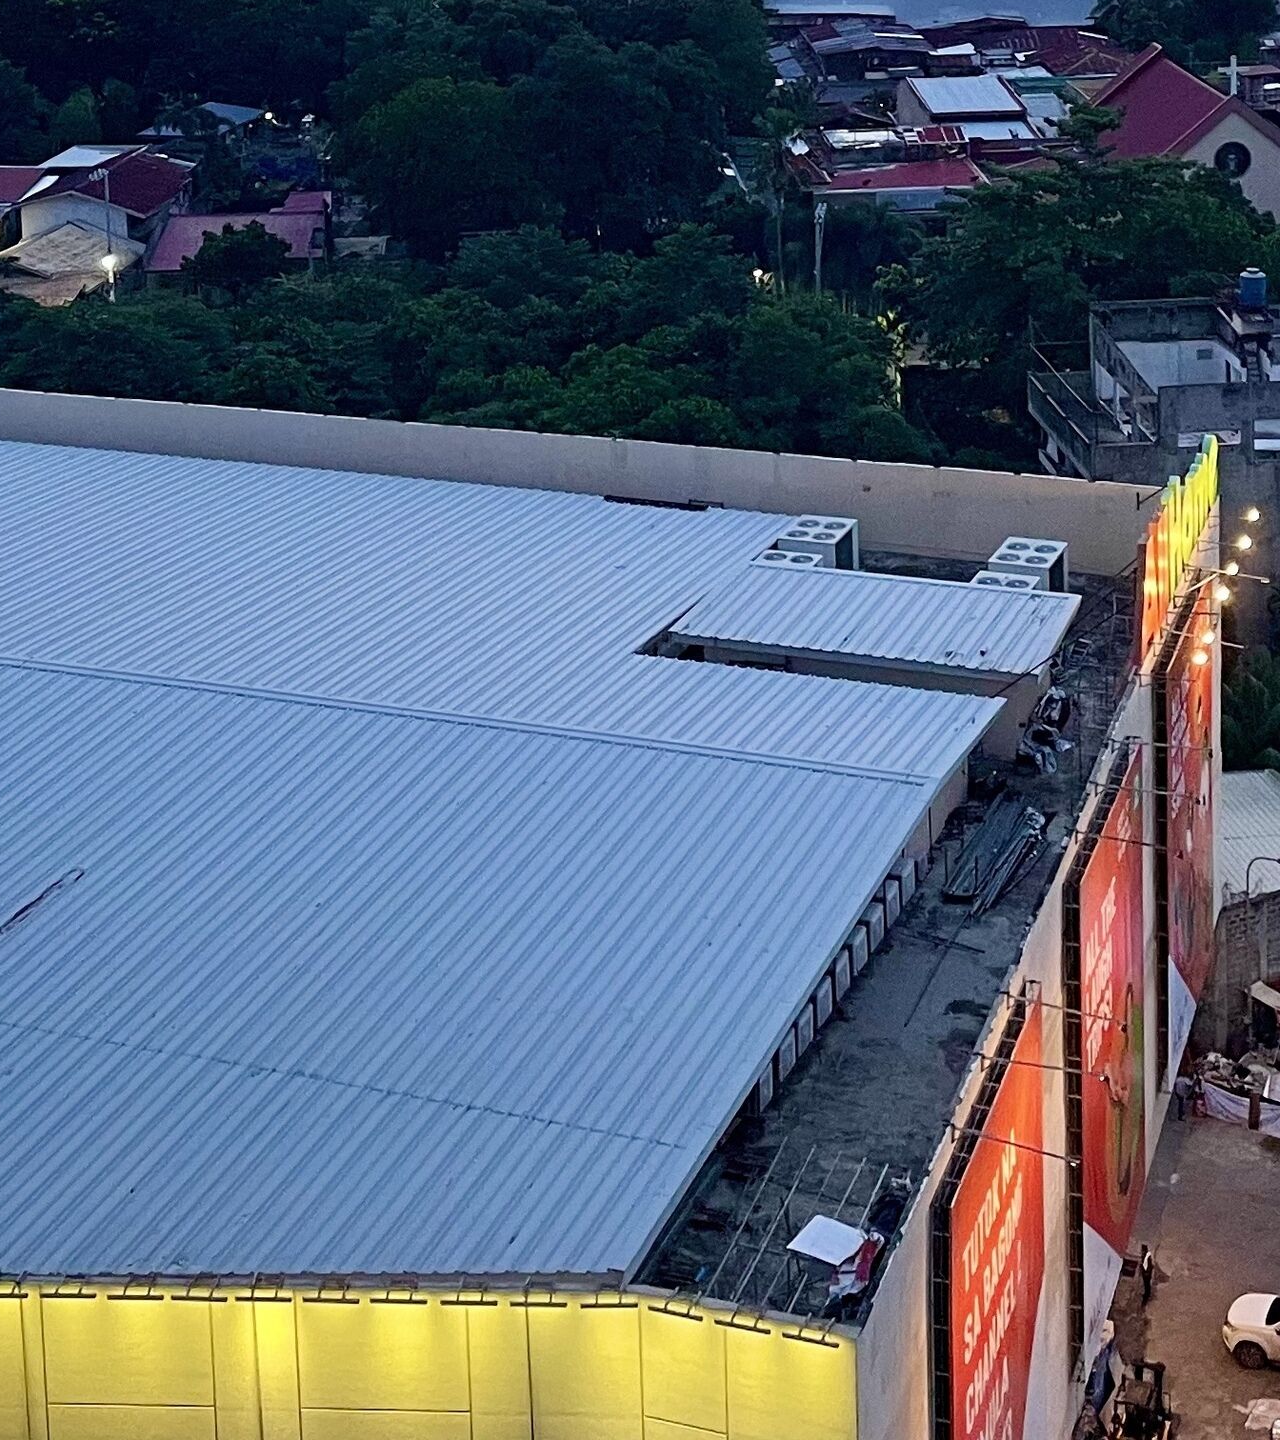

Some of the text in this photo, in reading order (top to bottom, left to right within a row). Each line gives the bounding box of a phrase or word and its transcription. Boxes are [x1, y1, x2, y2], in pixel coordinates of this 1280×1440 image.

[962, 1127, 1017, 1293] TUTOK NA
[964, 1295, 982, 1364] SA
